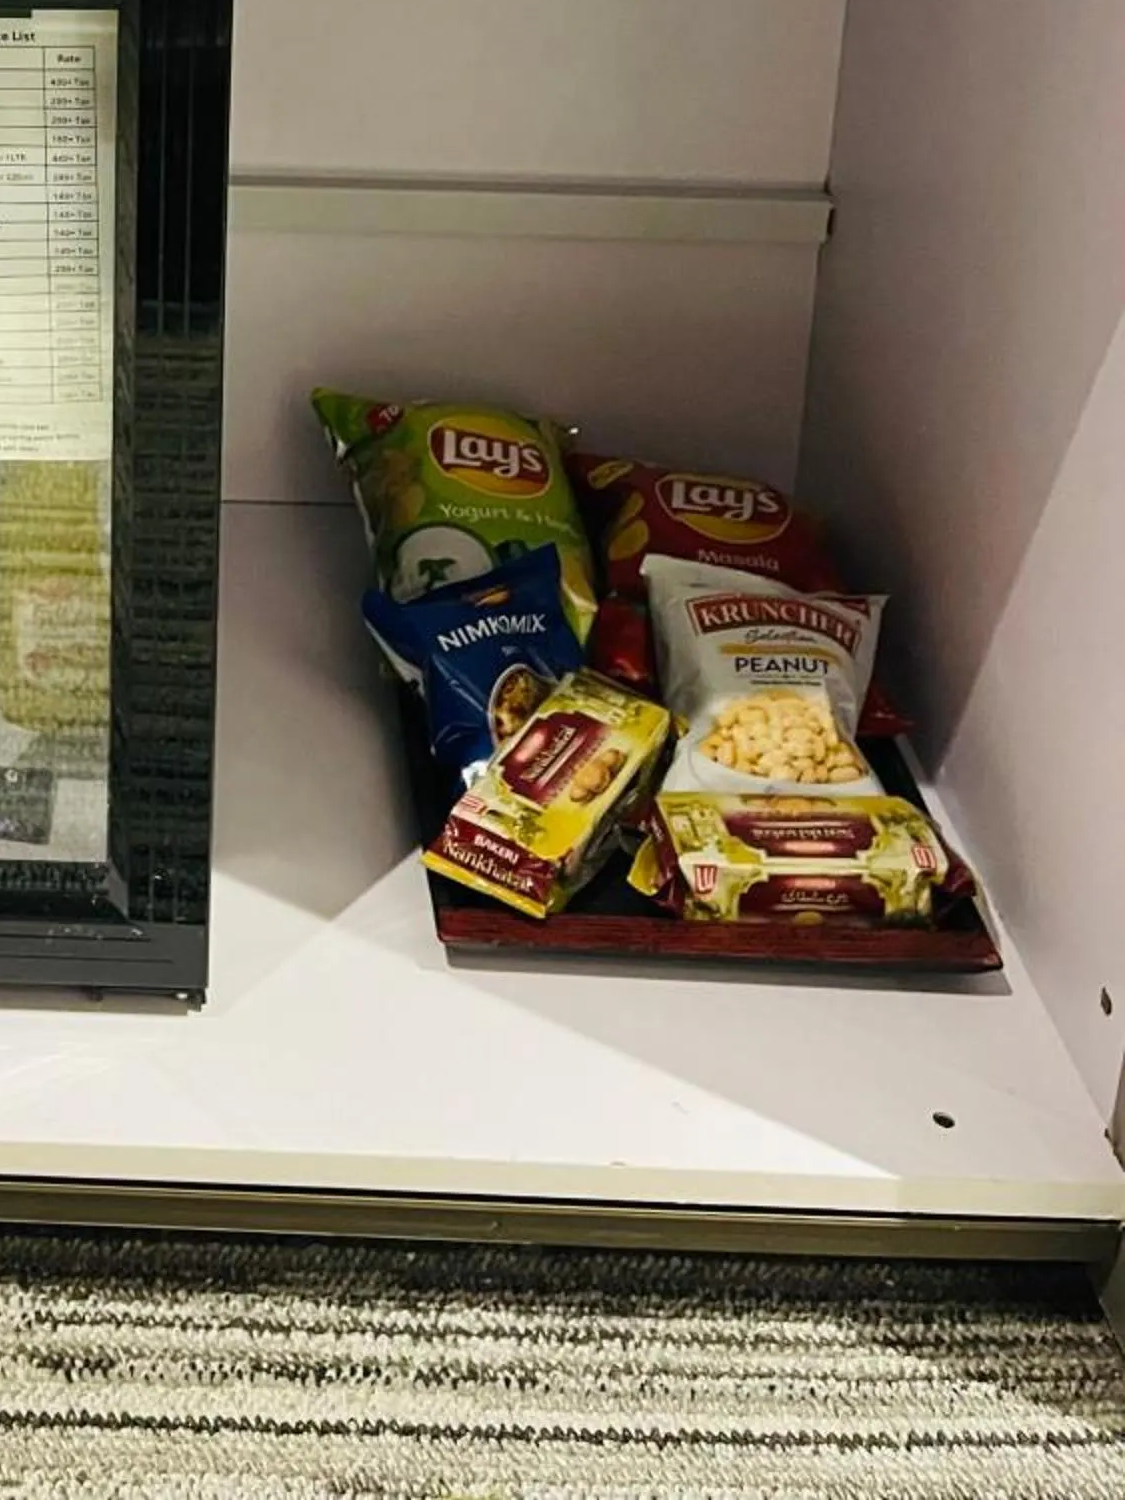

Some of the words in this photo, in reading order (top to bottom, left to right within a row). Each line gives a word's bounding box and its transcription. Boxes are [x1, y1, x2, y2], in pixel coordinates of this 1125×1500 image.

[12, 32, 36, 42] List
[57, 54, 81, 63] Rate
[443, 428, 543, 478] Lay's
[671, 480, 779, 522] Lay's
[438, 502, 511, 523] Yogurt
[697, 549, 780, 572] Masala
[734, 656, 829, 675] PEANUT
